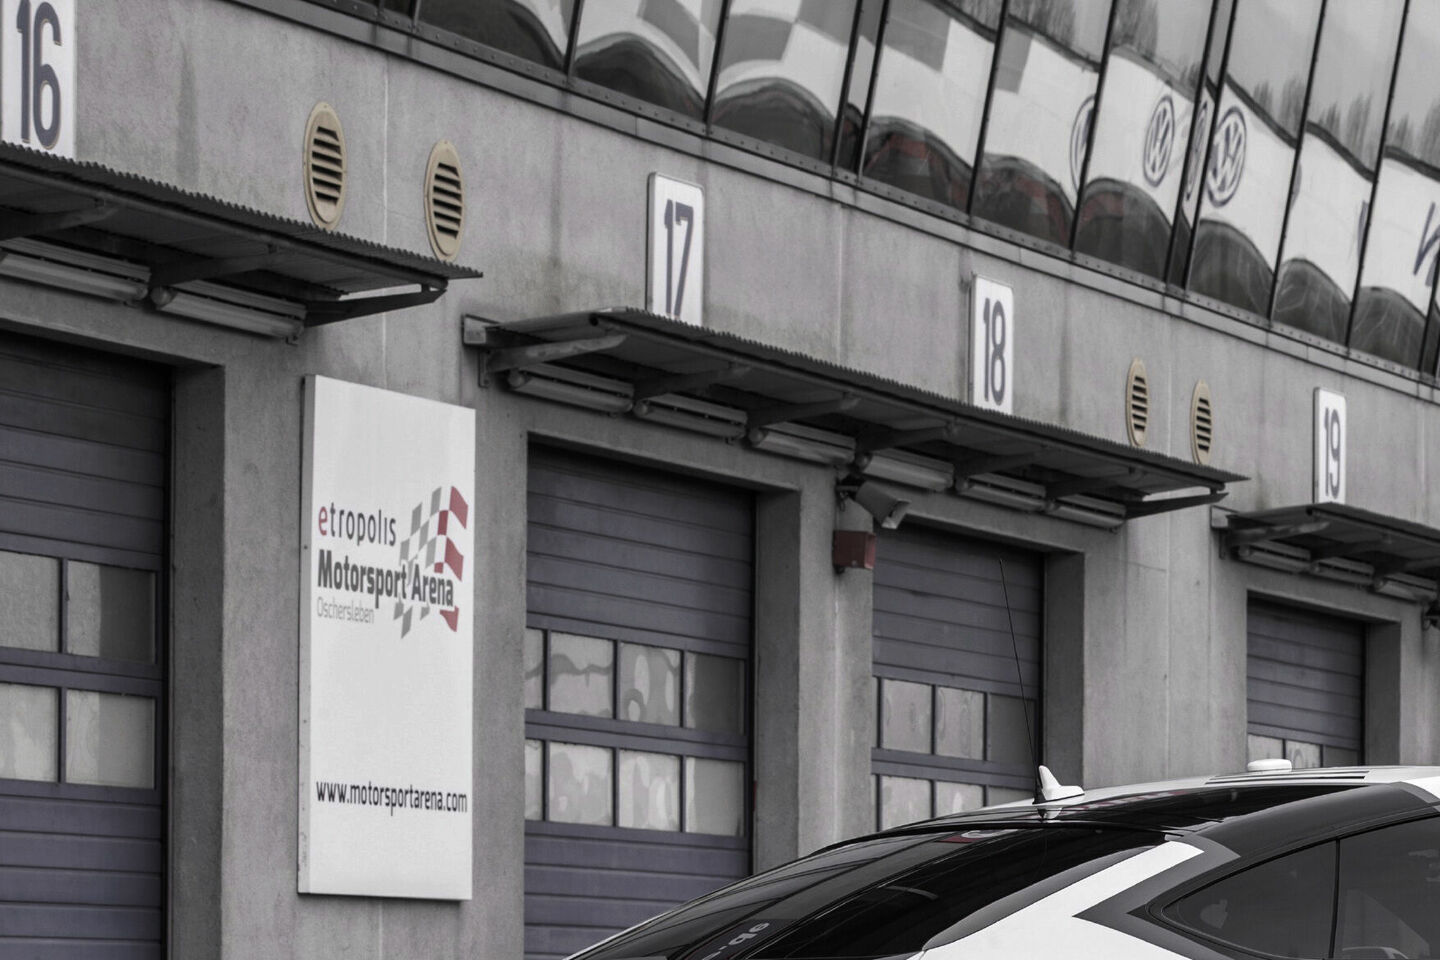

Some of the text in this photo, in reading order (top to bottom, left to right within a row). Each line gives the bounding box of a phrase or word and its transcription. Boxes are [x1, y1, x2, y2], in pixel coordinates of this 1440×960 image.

[16, 0, 62, 150] 16
[664, 198, 694, 319] 17
[983, 297, 1006, 407] 18
[1324, 407, 1341, 500] 19
[318, 502, 396, 547] etropolis
[317, 549, 454, 609] Motorsport Arena
[317, 596, 375, 624] Oschersleben
[316, 781, 468, 816] www.motorsportarena.com
